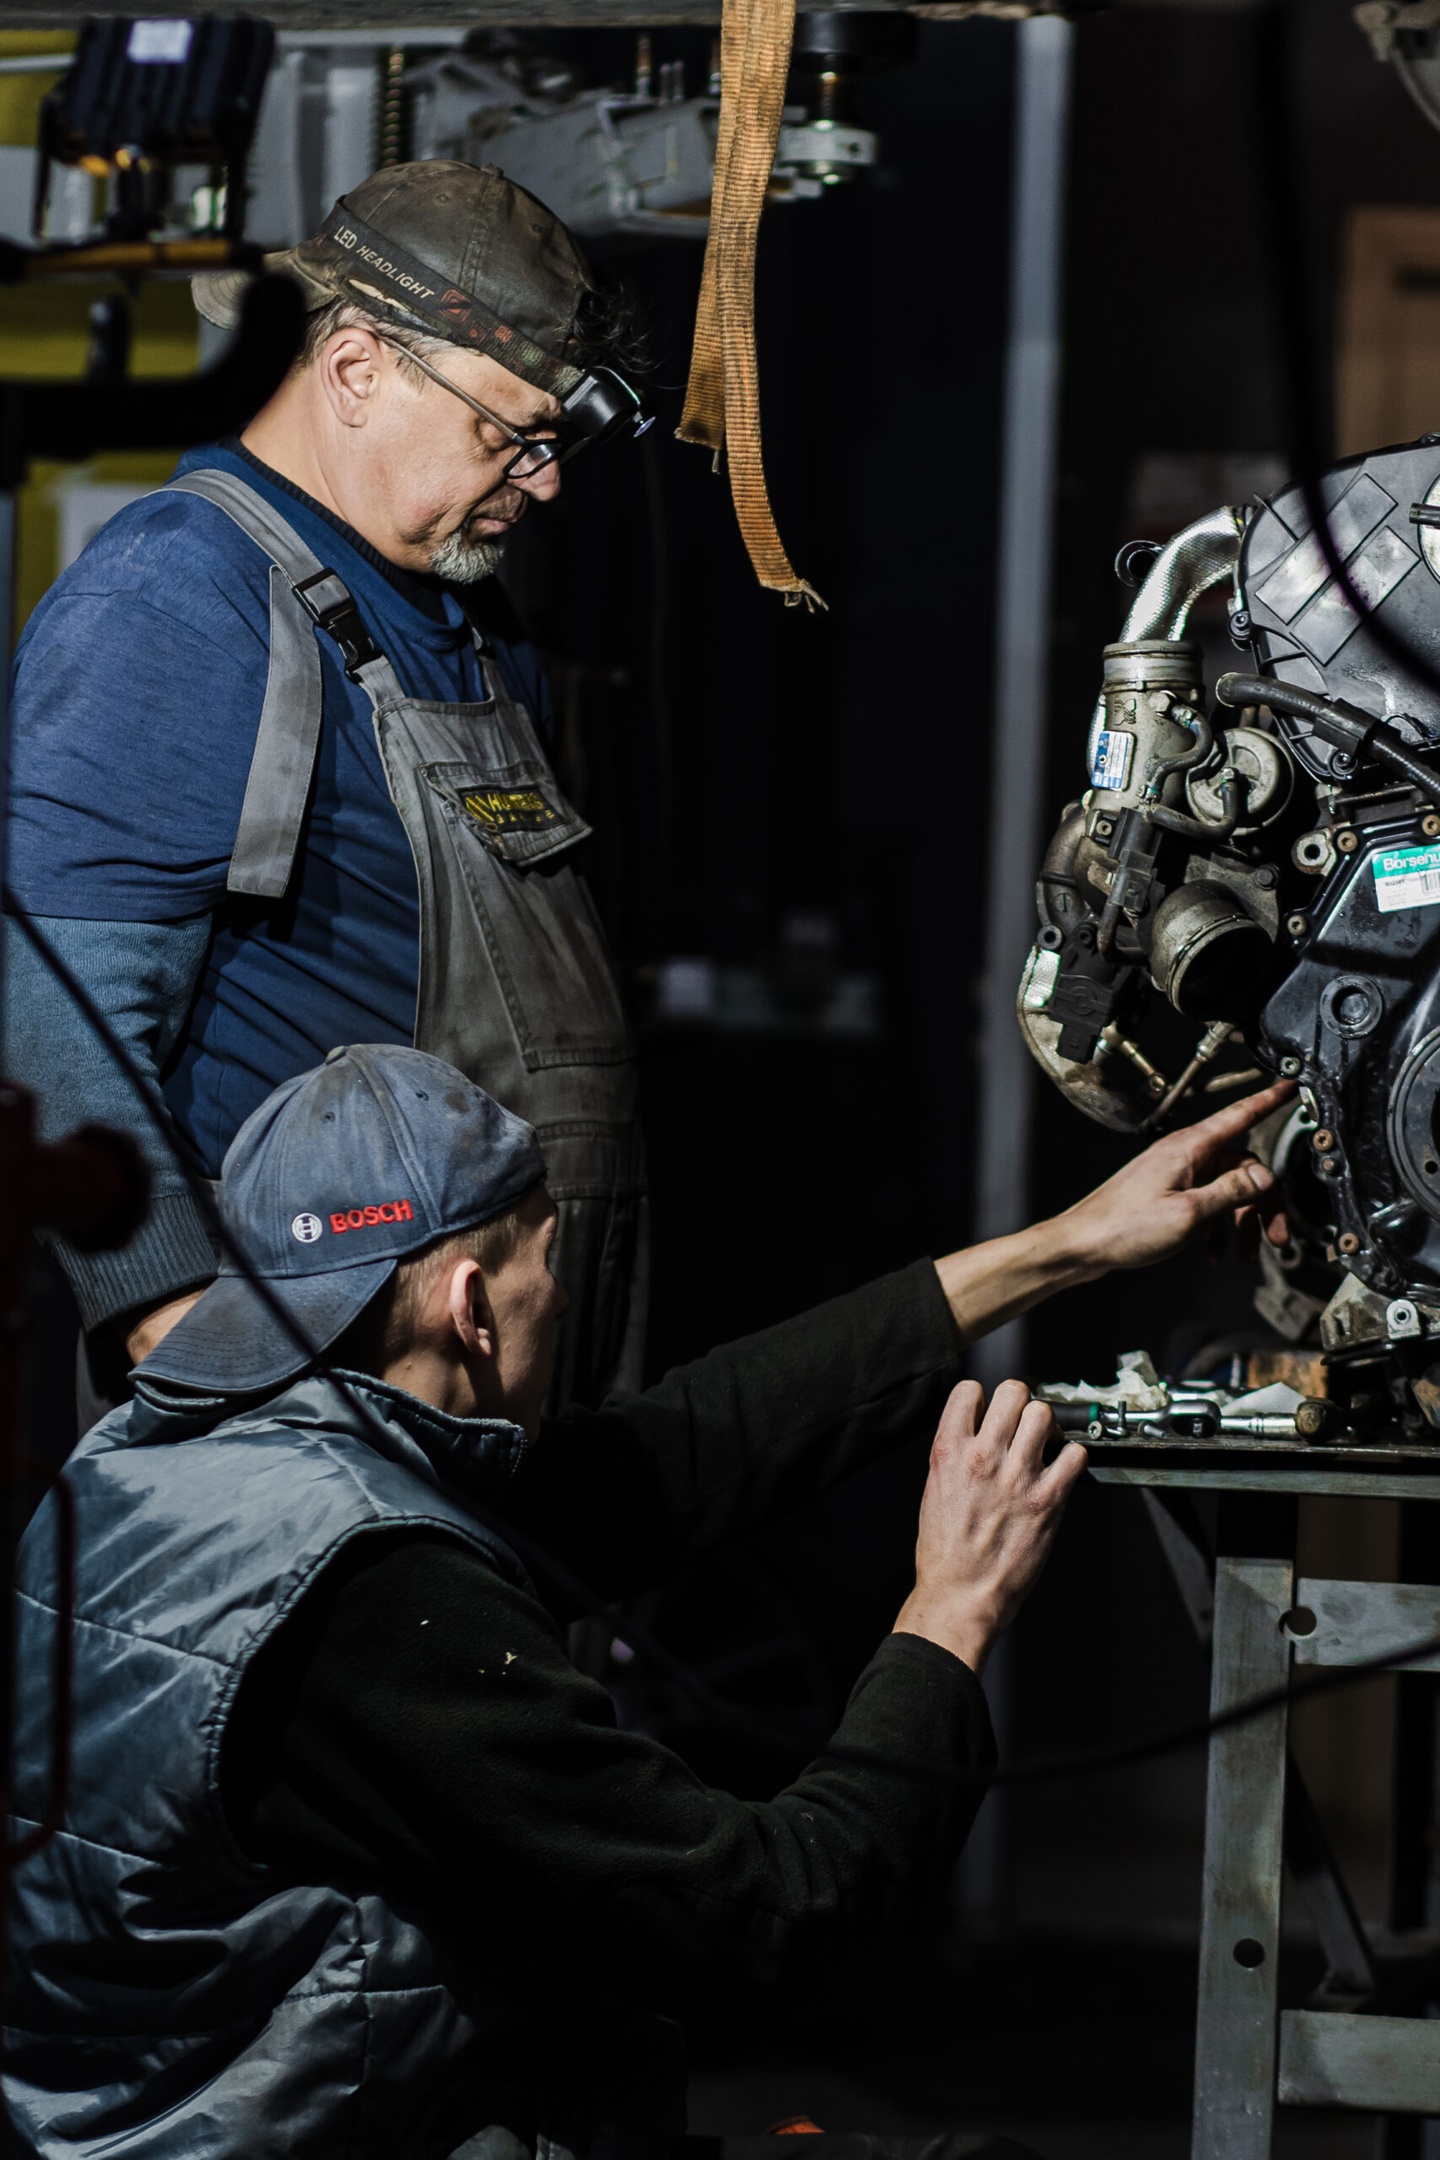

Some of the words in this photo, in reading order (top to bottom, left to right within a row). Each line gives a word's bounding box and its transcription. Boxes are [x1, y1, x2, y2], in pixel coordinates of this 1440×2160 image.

[334, 226, 357, 249] LED
[357, 246, 435, 299] HEADLIGHT
[330, 1199, 413, 1233] BOSCH
